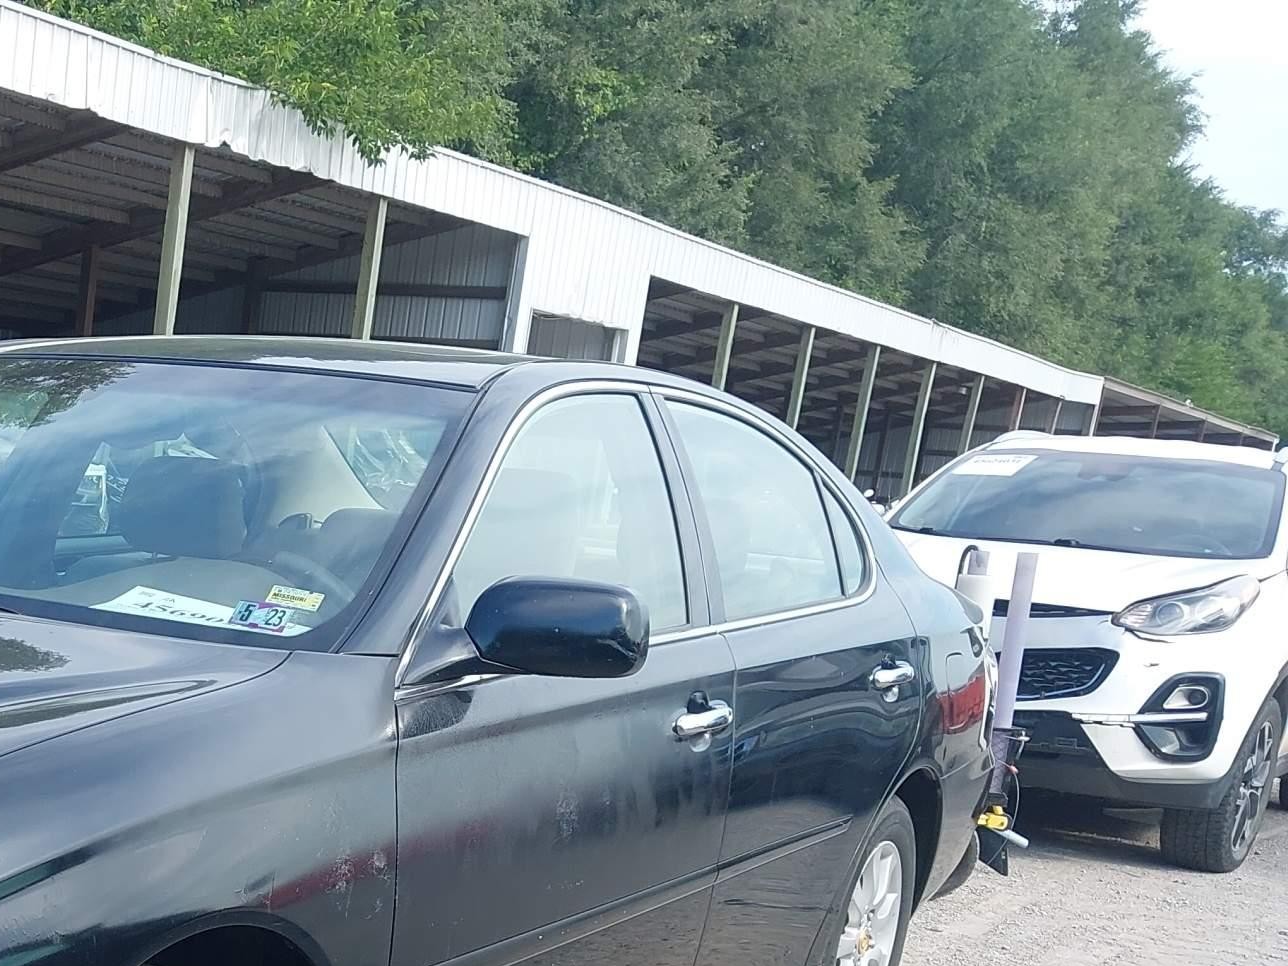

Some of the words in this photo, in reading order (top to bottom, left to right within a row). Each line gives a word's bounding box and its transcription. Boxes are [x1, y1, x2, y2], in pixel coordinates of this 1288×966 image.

[271, 592, 308, 603] MISSOURI
[239, 603, 257, 622] 5
[264, 608, 287, 627] 23
